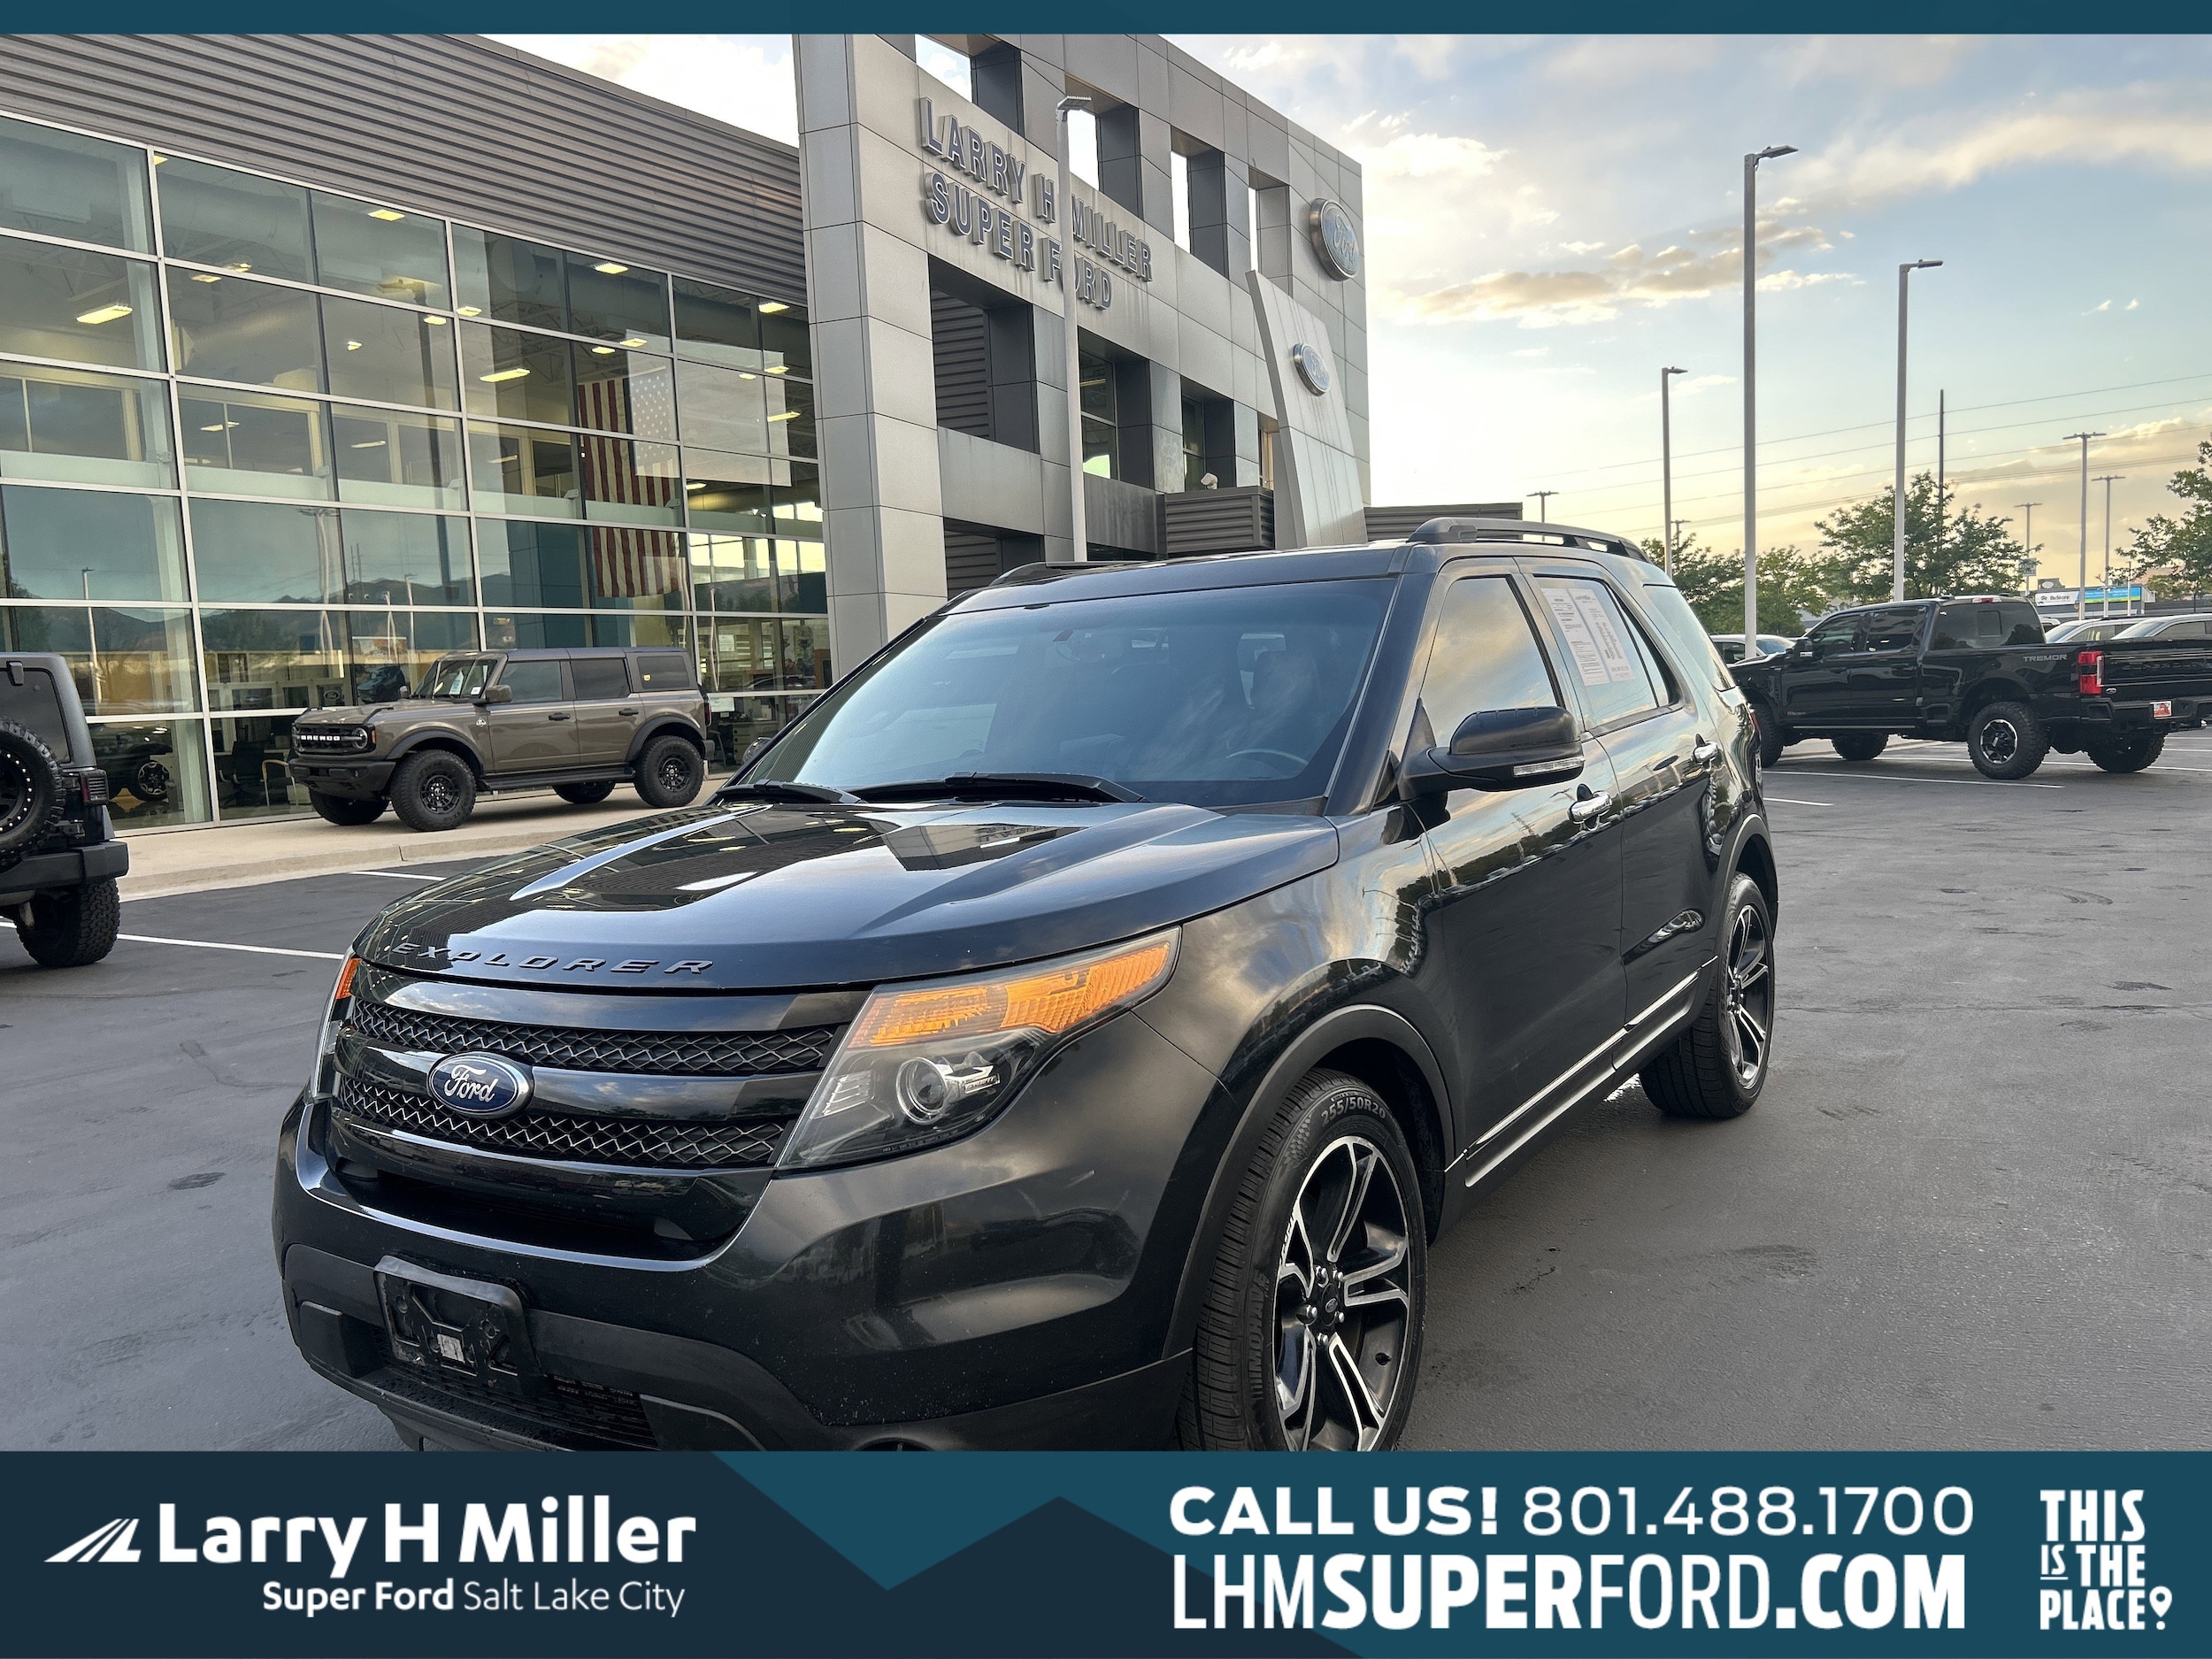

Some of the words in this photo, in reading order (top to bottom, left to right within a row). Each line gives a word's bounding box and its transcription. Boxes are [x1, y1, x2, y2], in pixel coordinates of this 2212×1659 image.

[921, 96, 1026, 204] LARRY
[1034, 173, 1056, 224] H
[1071, 193, 1153, 282] MILLER
[926, 172, 1035, 272] SUPER
[1041, 236, 1112, 310] FRD
[392, 941, 713, 975] EXPLORER
[443, 1063, 500, 1103] Ford
[1321, 1096, 1386, 1127] 255/50R20
